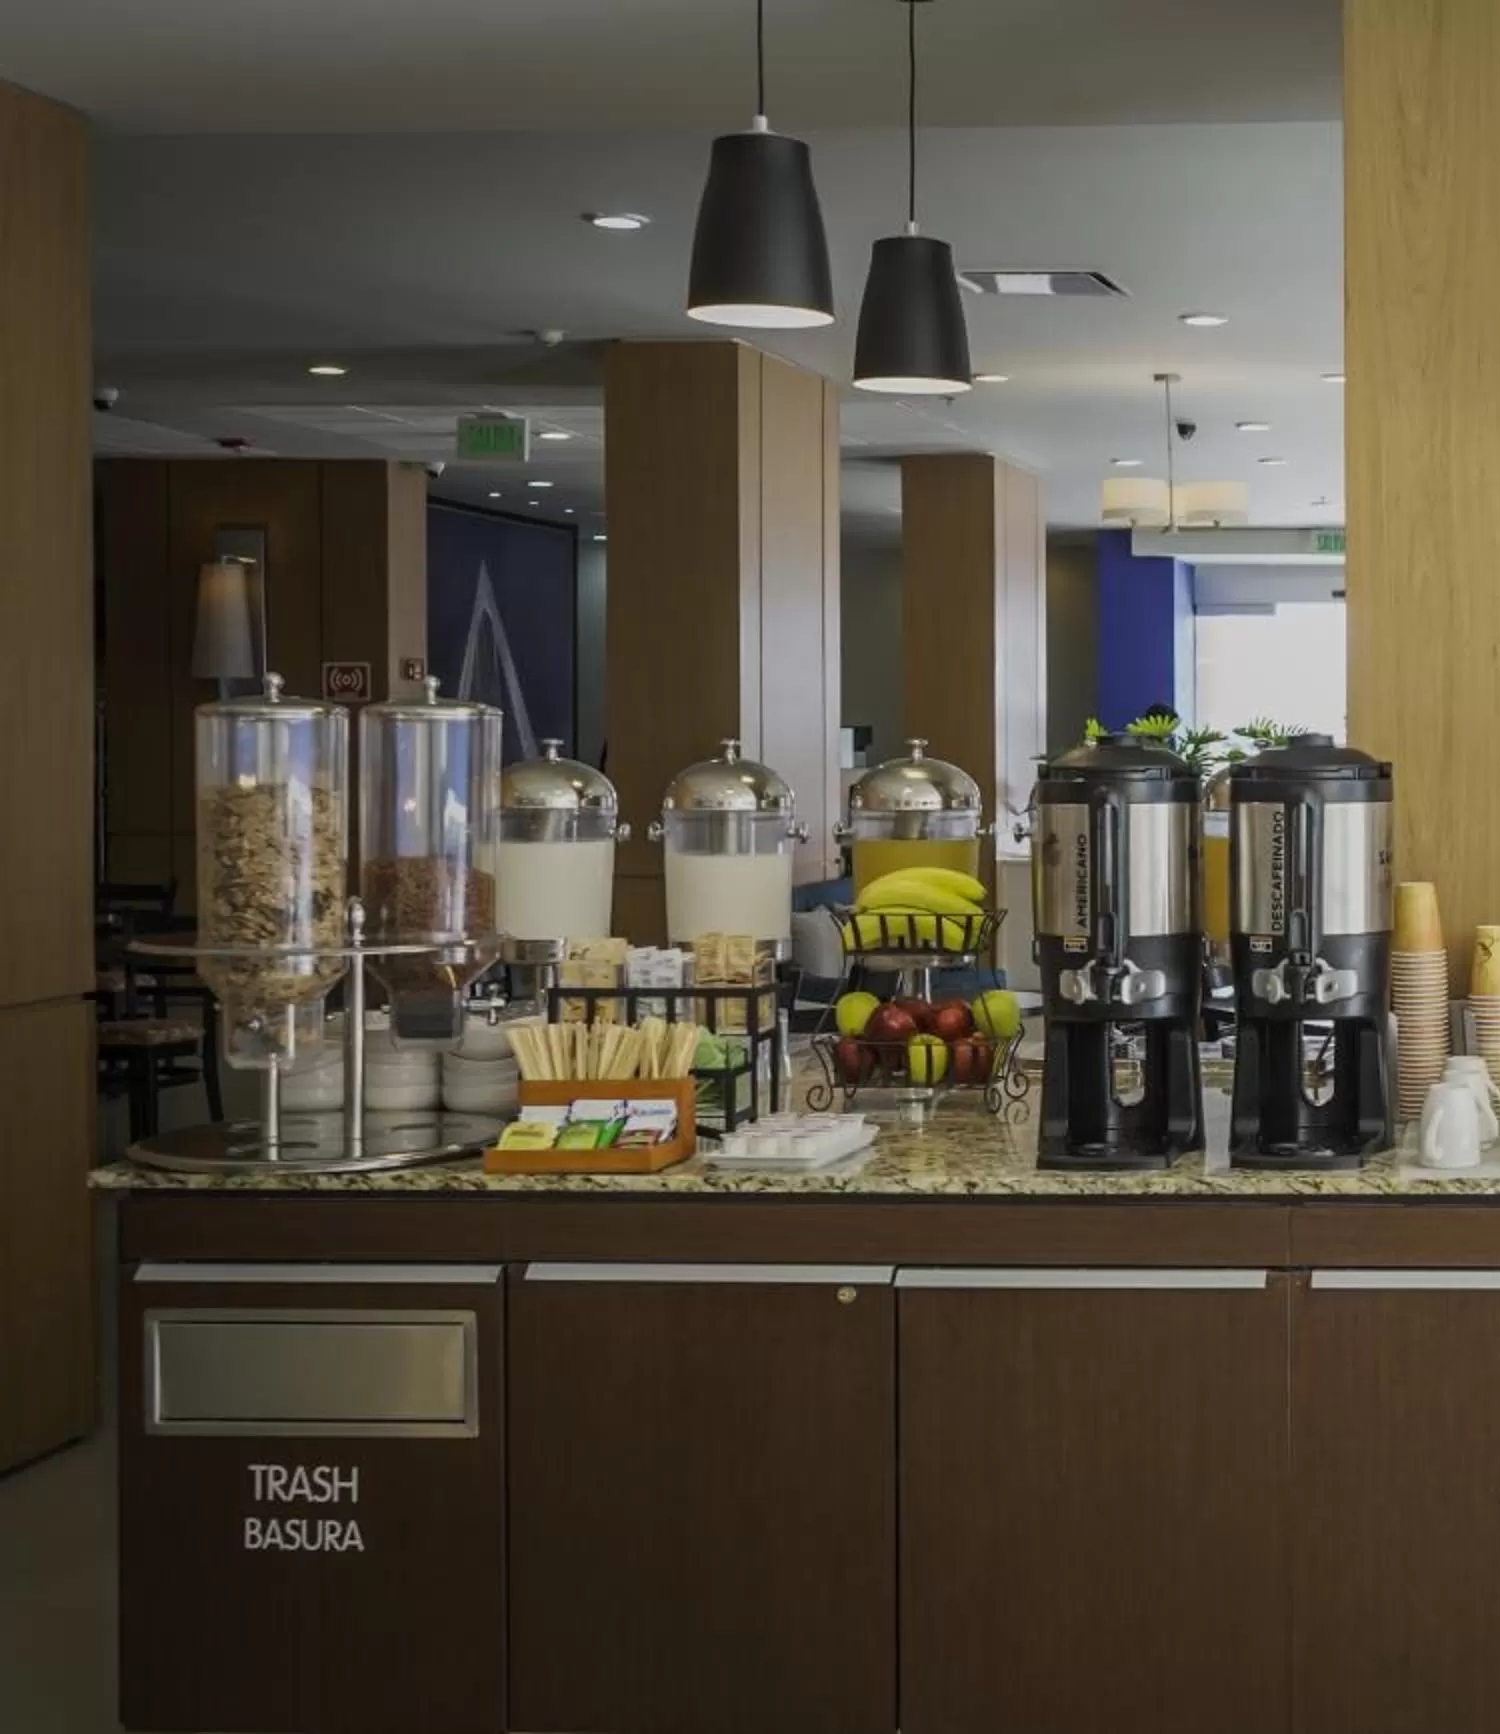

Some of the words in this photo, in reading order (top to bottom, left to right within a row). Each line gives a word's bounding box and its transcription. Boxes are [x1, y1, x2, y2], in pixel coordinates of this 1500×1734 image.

[1076, 833, 1089, 929] AMERICANO
[1271, 810, 1284, 932] DESCAFEINADO
[247, 1464, 359, 1503] TRASH
[244, 1517, 365, 1552] BASURA
